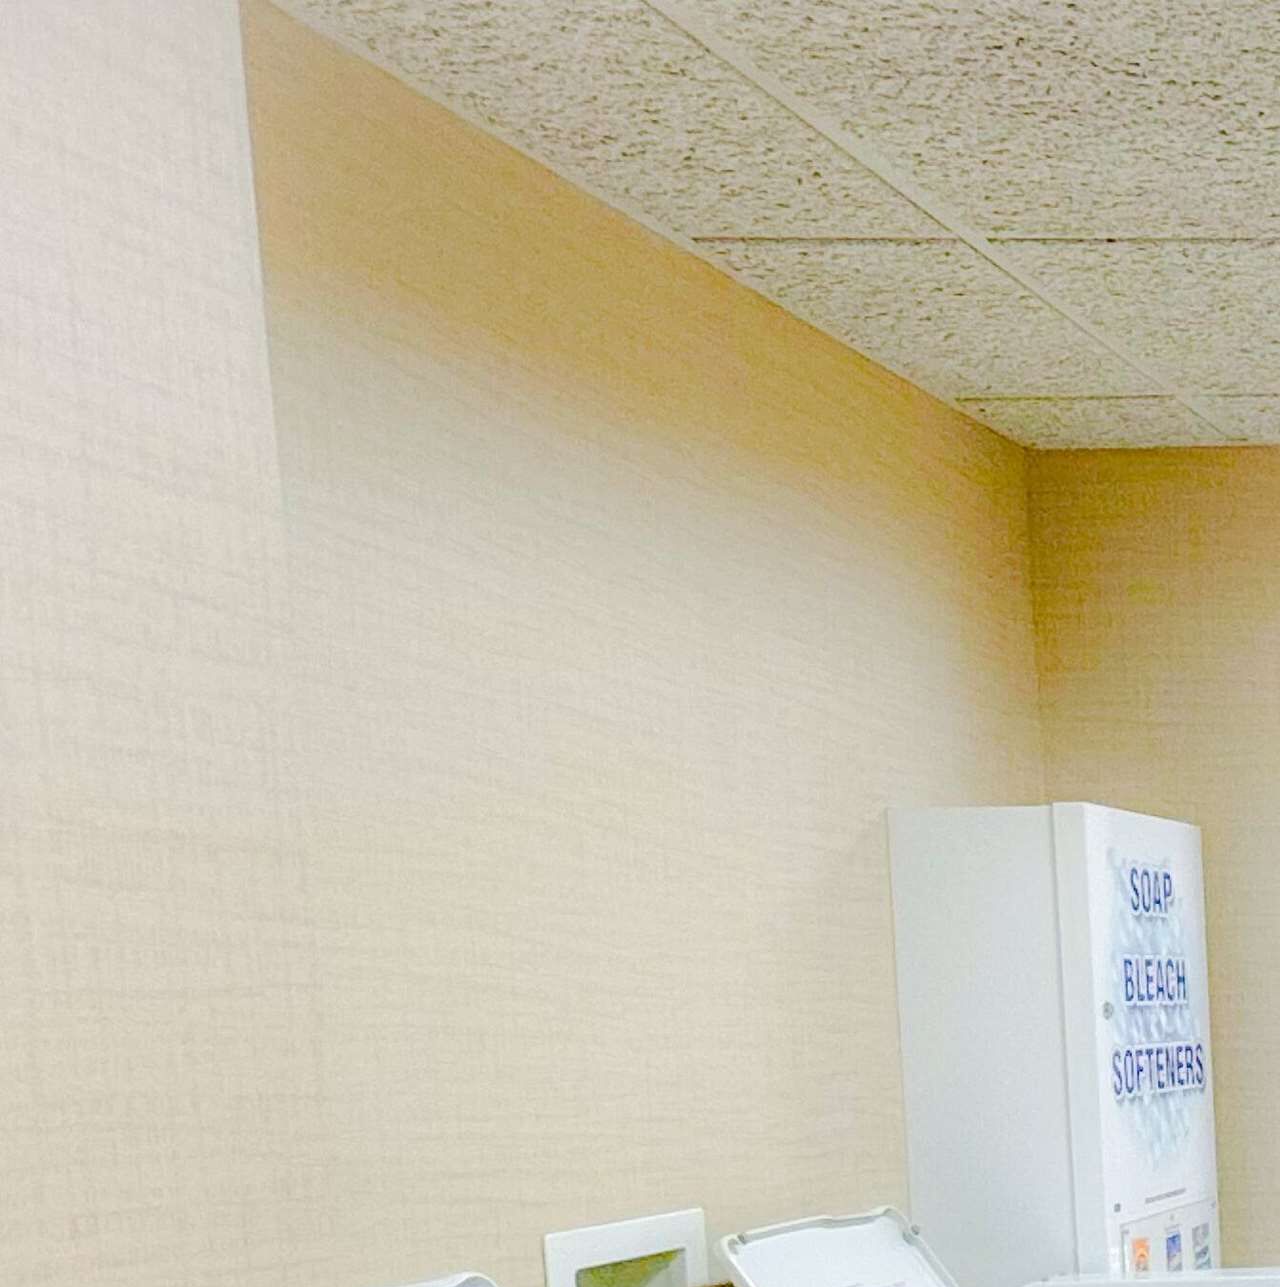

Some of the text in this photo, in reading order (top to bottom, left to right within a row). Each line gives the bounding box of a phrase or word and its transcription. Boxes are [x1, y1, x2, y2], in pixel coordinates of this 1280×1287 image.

[1129, 866, 1173, 913] SOAP
[1122, 958, 1187, 1002] BLEACH
[1111, 1043, 1205, 1096] SOFTENERS
